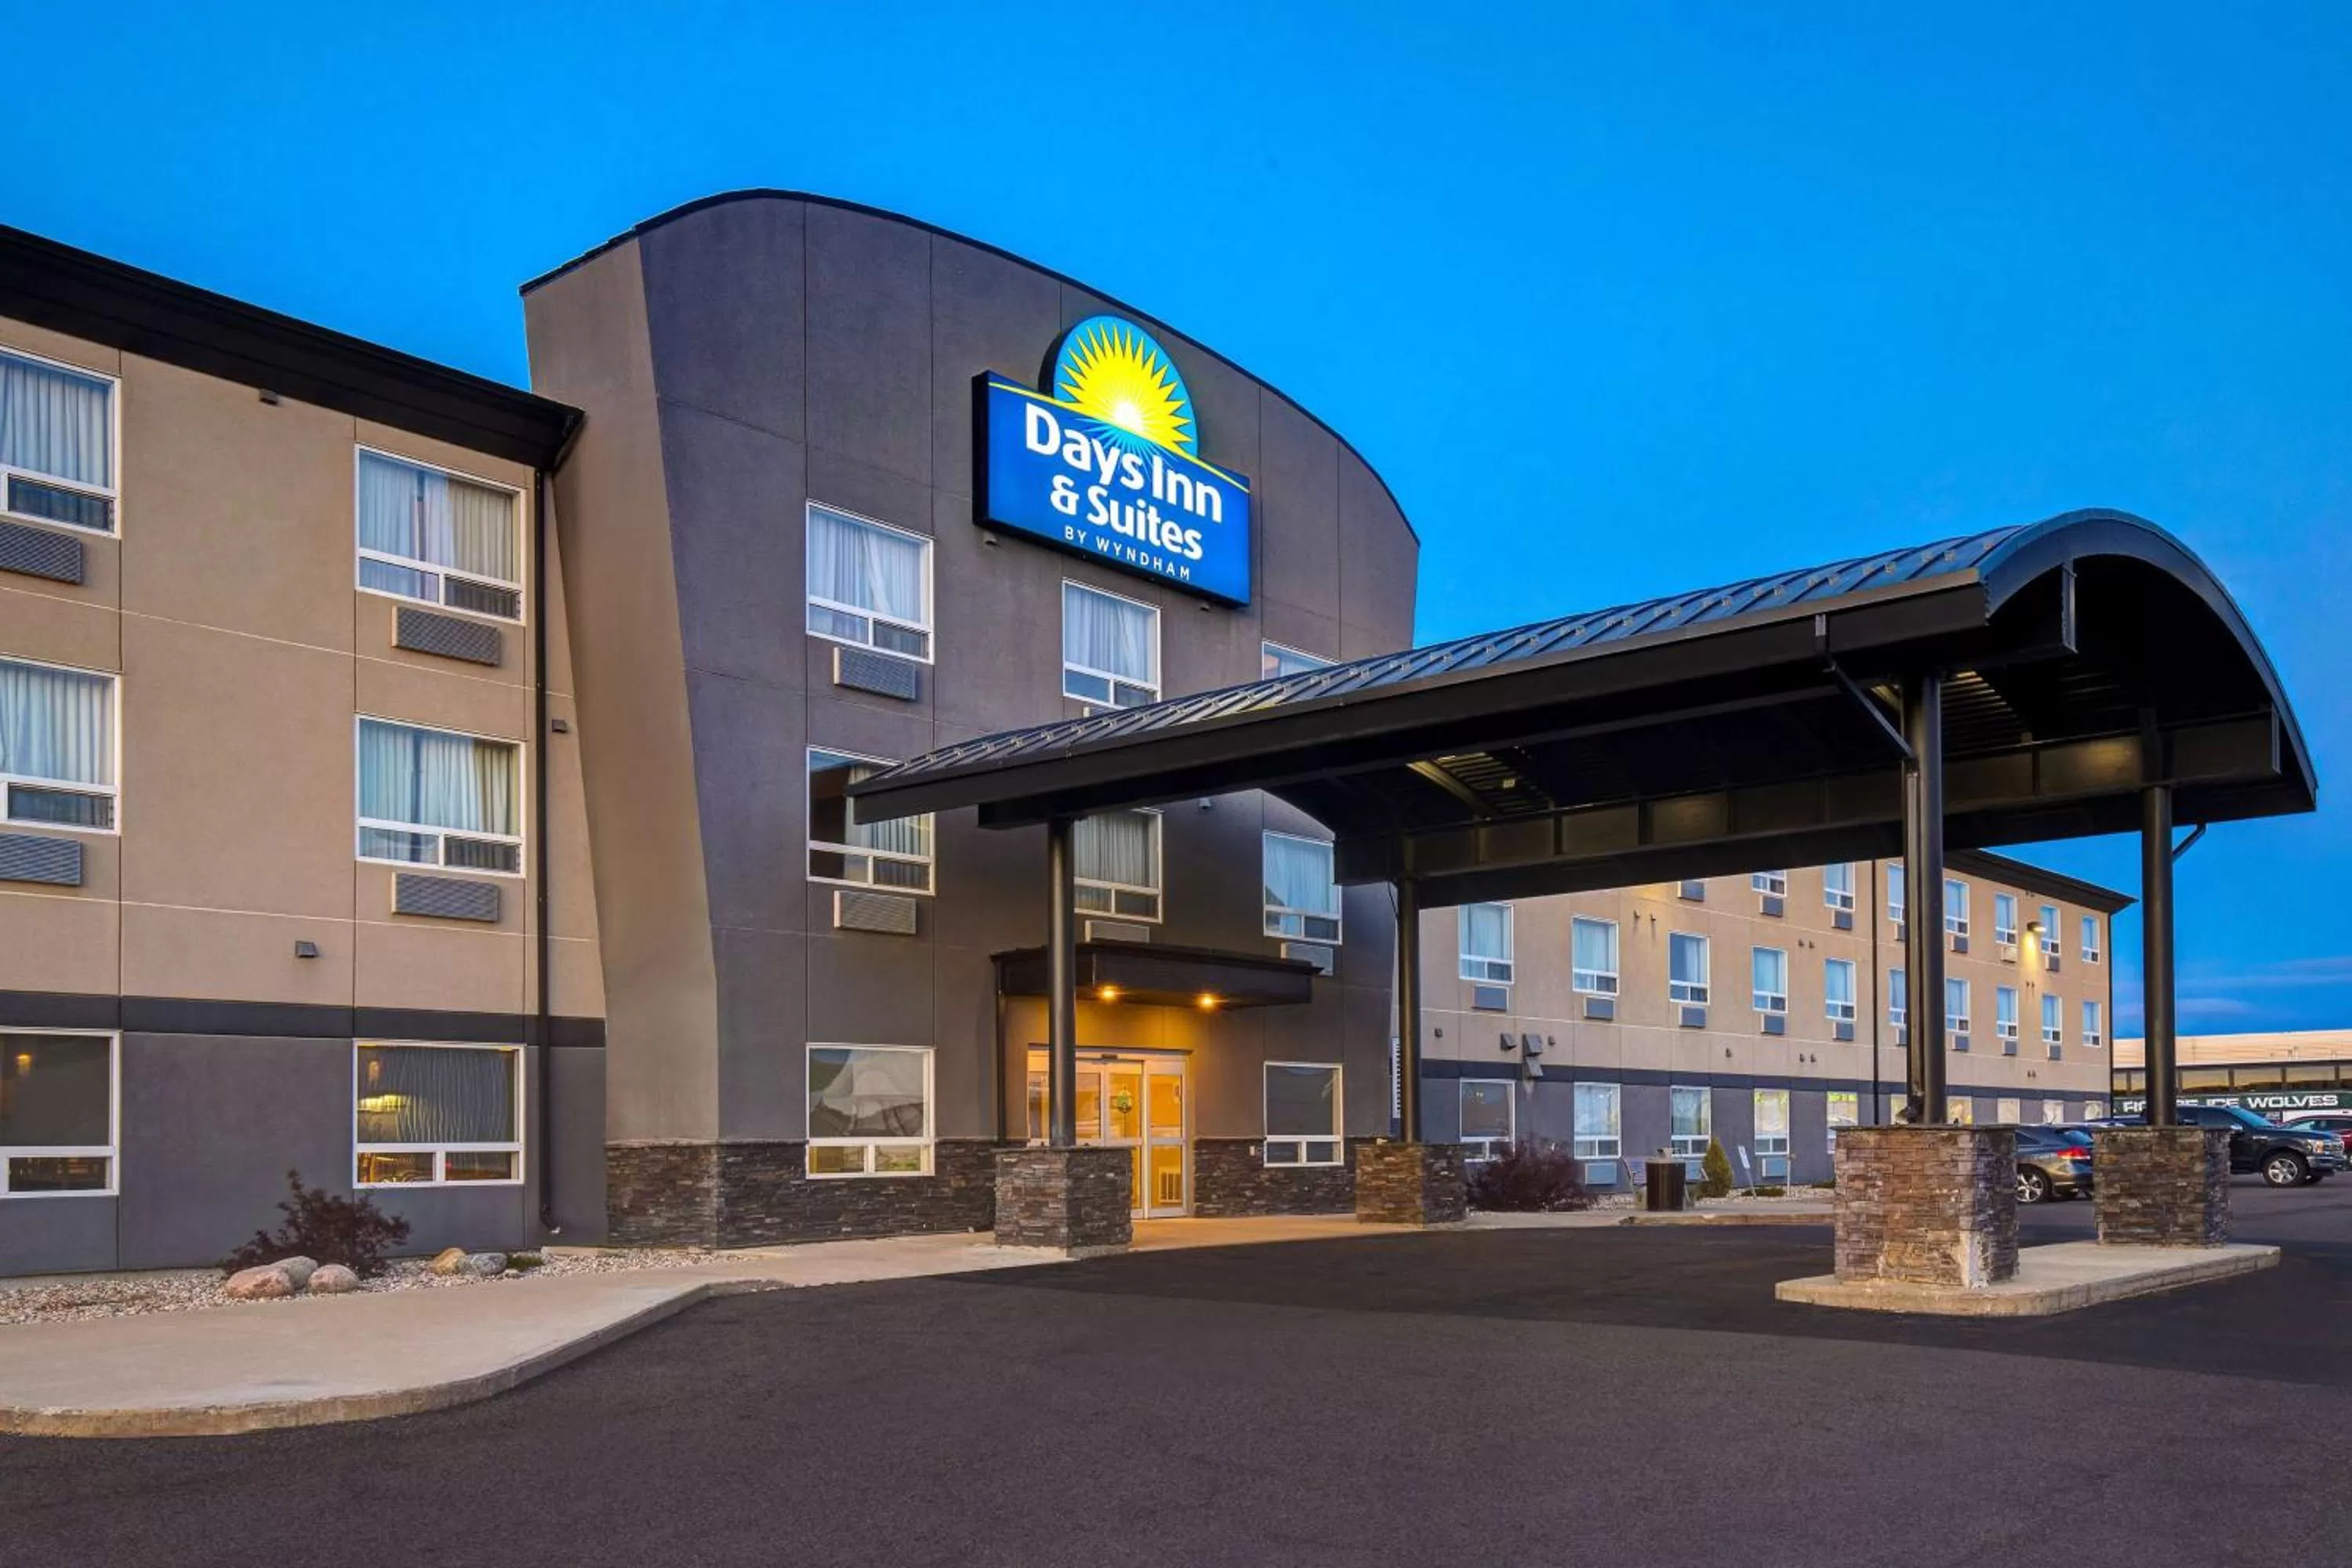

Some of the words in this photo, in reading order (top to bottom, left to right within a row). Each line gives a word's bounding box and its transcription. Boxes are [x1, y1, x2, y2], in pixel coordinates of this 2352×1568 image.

[1025, 401, 1145, 491] Days
[1152, 454, 1223, 524] Inn
[1050, 474, 1080, 516] &
[1087, 485, 1203, 561] Suites
[1064, 524, 1087, 545] BY
[1095, 535, 1190, 581] WYNDHAM
[2246, 1094, 2339, 1108] WOLVES
